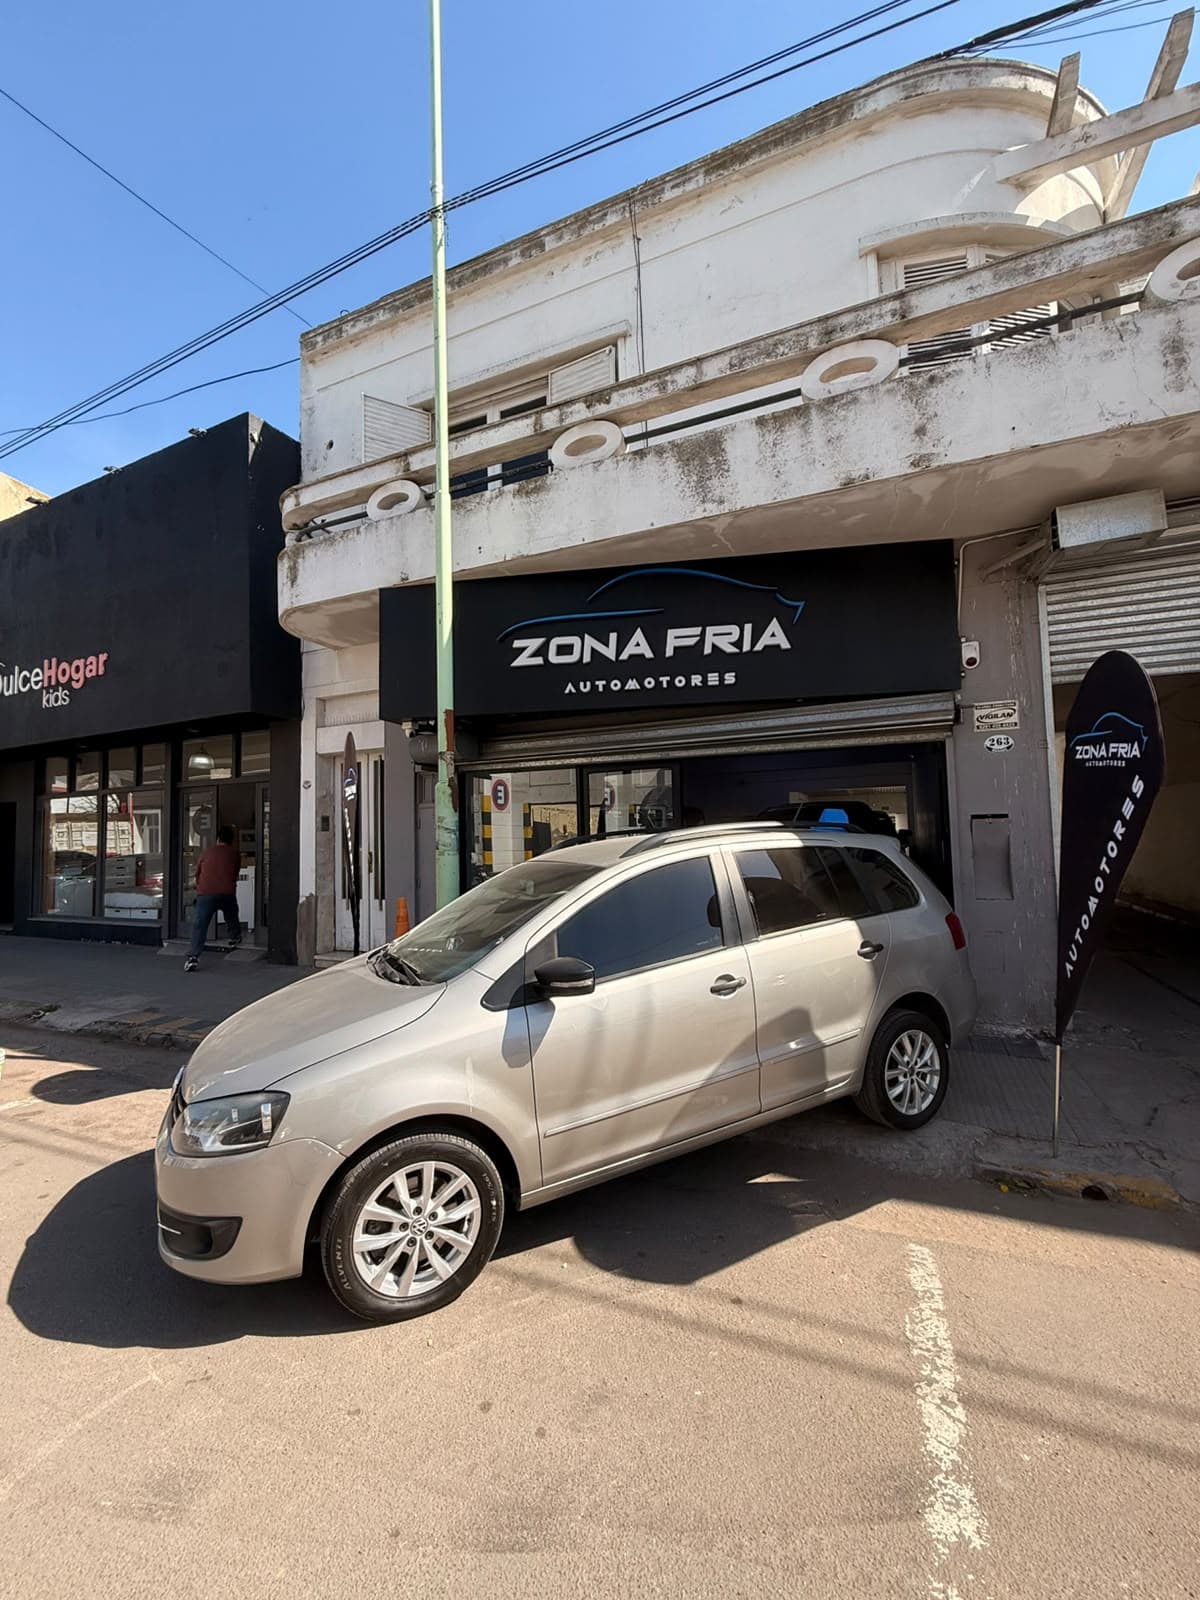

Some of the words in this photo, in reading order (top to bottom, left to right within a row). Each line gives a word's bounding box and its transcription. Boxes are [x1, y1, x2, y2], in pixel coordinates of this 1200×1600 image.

[510, 627, 655, 667] ZONA
[665, 616, 792, 658] FRIA
[0, 653, 108, 697] ulceHogar
[564, 672, 736, 694] AUTOMOTORES
[42, 687, 70, 708] kids
[988, 737, 1010, 747] 263
[1075, 741, 1107, 759] ZONA
[1108, 740, 1141, 758] FRIA
[1065, 774, 1145, 979] AUTOMOTORES
